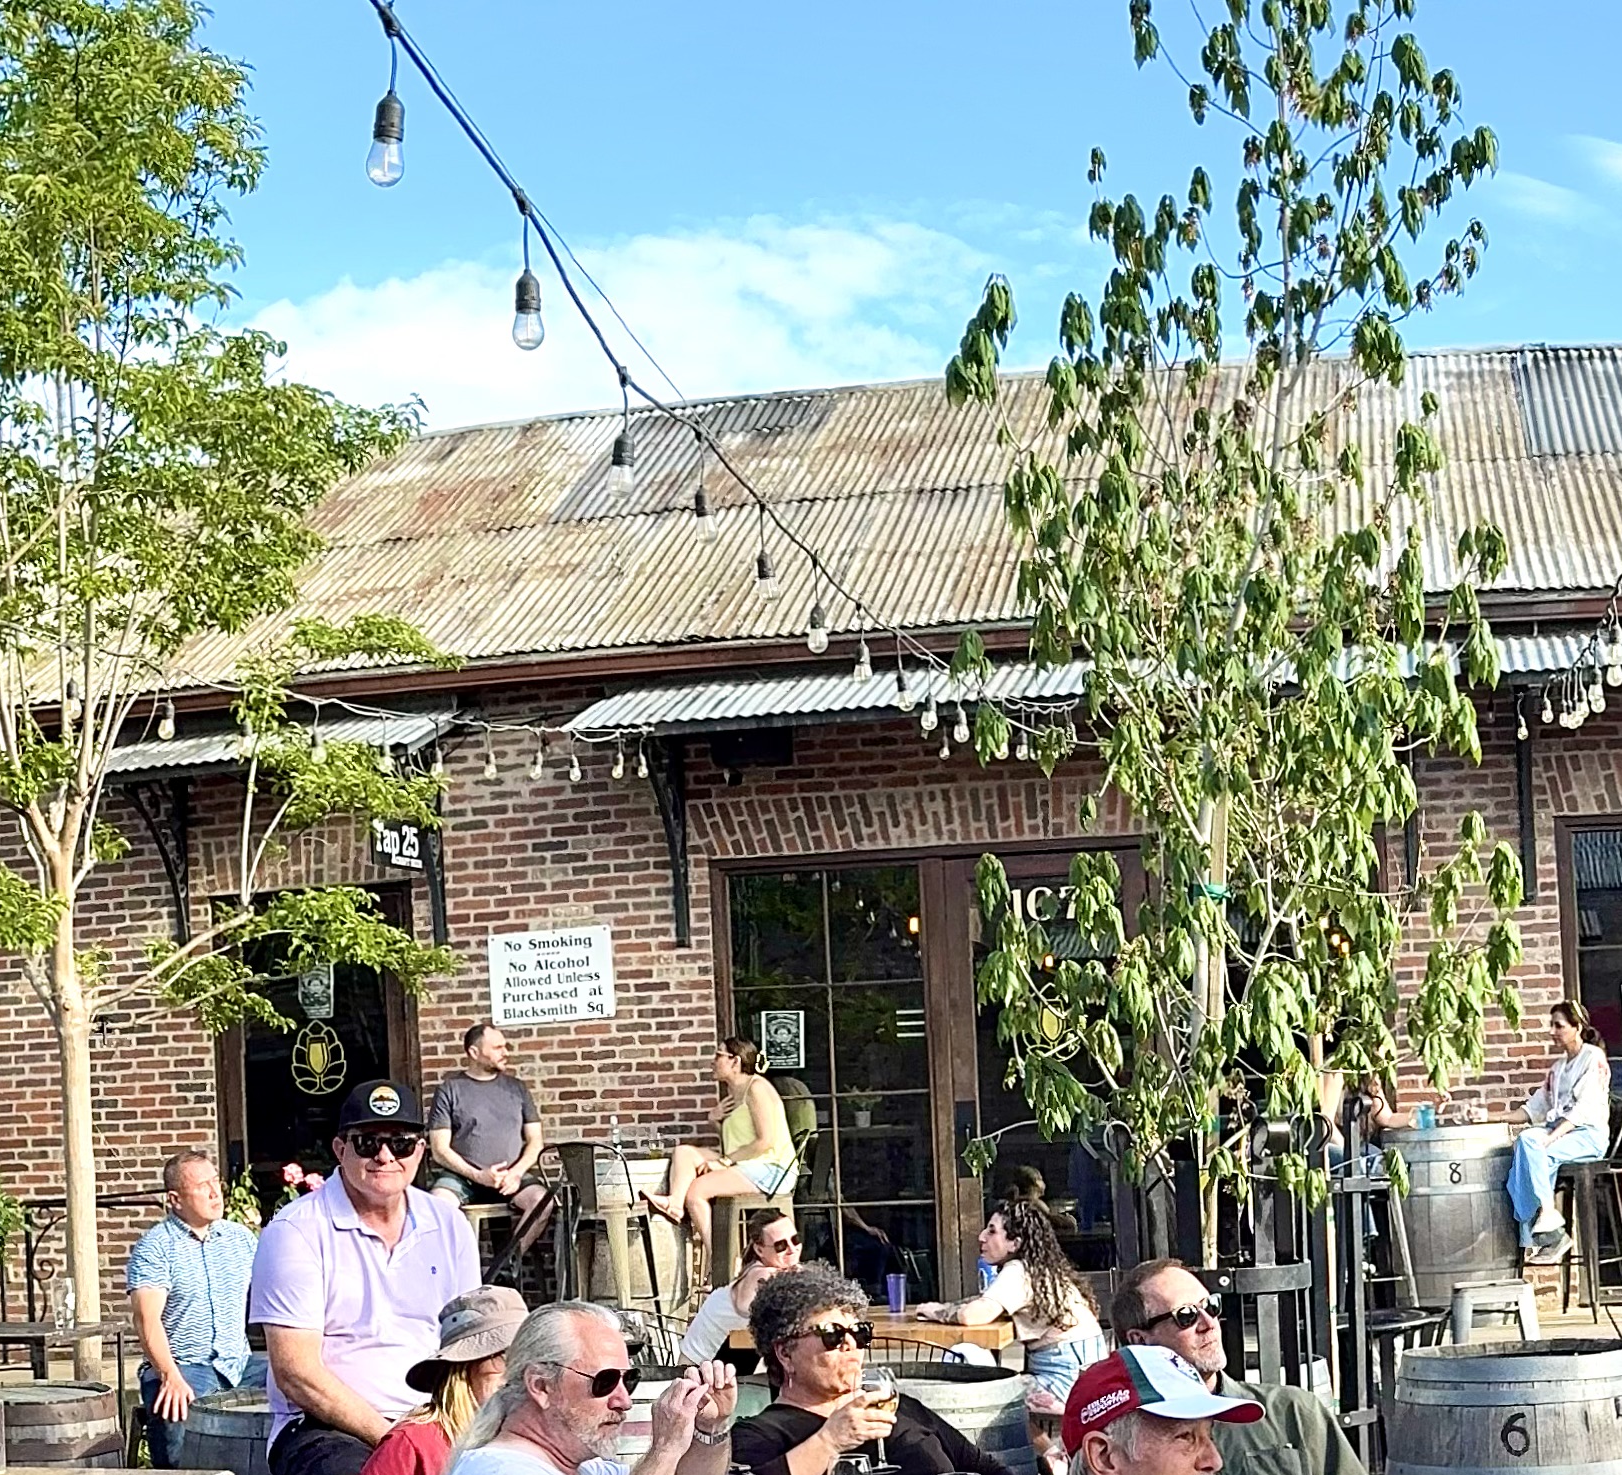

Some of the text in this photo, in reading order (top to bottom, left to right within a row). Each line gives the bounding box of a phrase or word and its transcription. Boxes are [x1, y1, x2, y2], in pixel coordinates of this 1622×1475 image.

[401, 824, 420, 858] 25
[1010, 886, 1078, 921] 107
[504, 935, 592, 952] No Smoking
[508, 955, 590, 973] No Alcohol
[503, 971, 601, 989] Allowed Unless
[502, 984, 604, 1003] Purchased at
[503, 1001, 604, 1019] Blacksmith Sq
[1449, 1162, 1462, 1184] 8
[1501, 1412, 1530, 1457] 6
